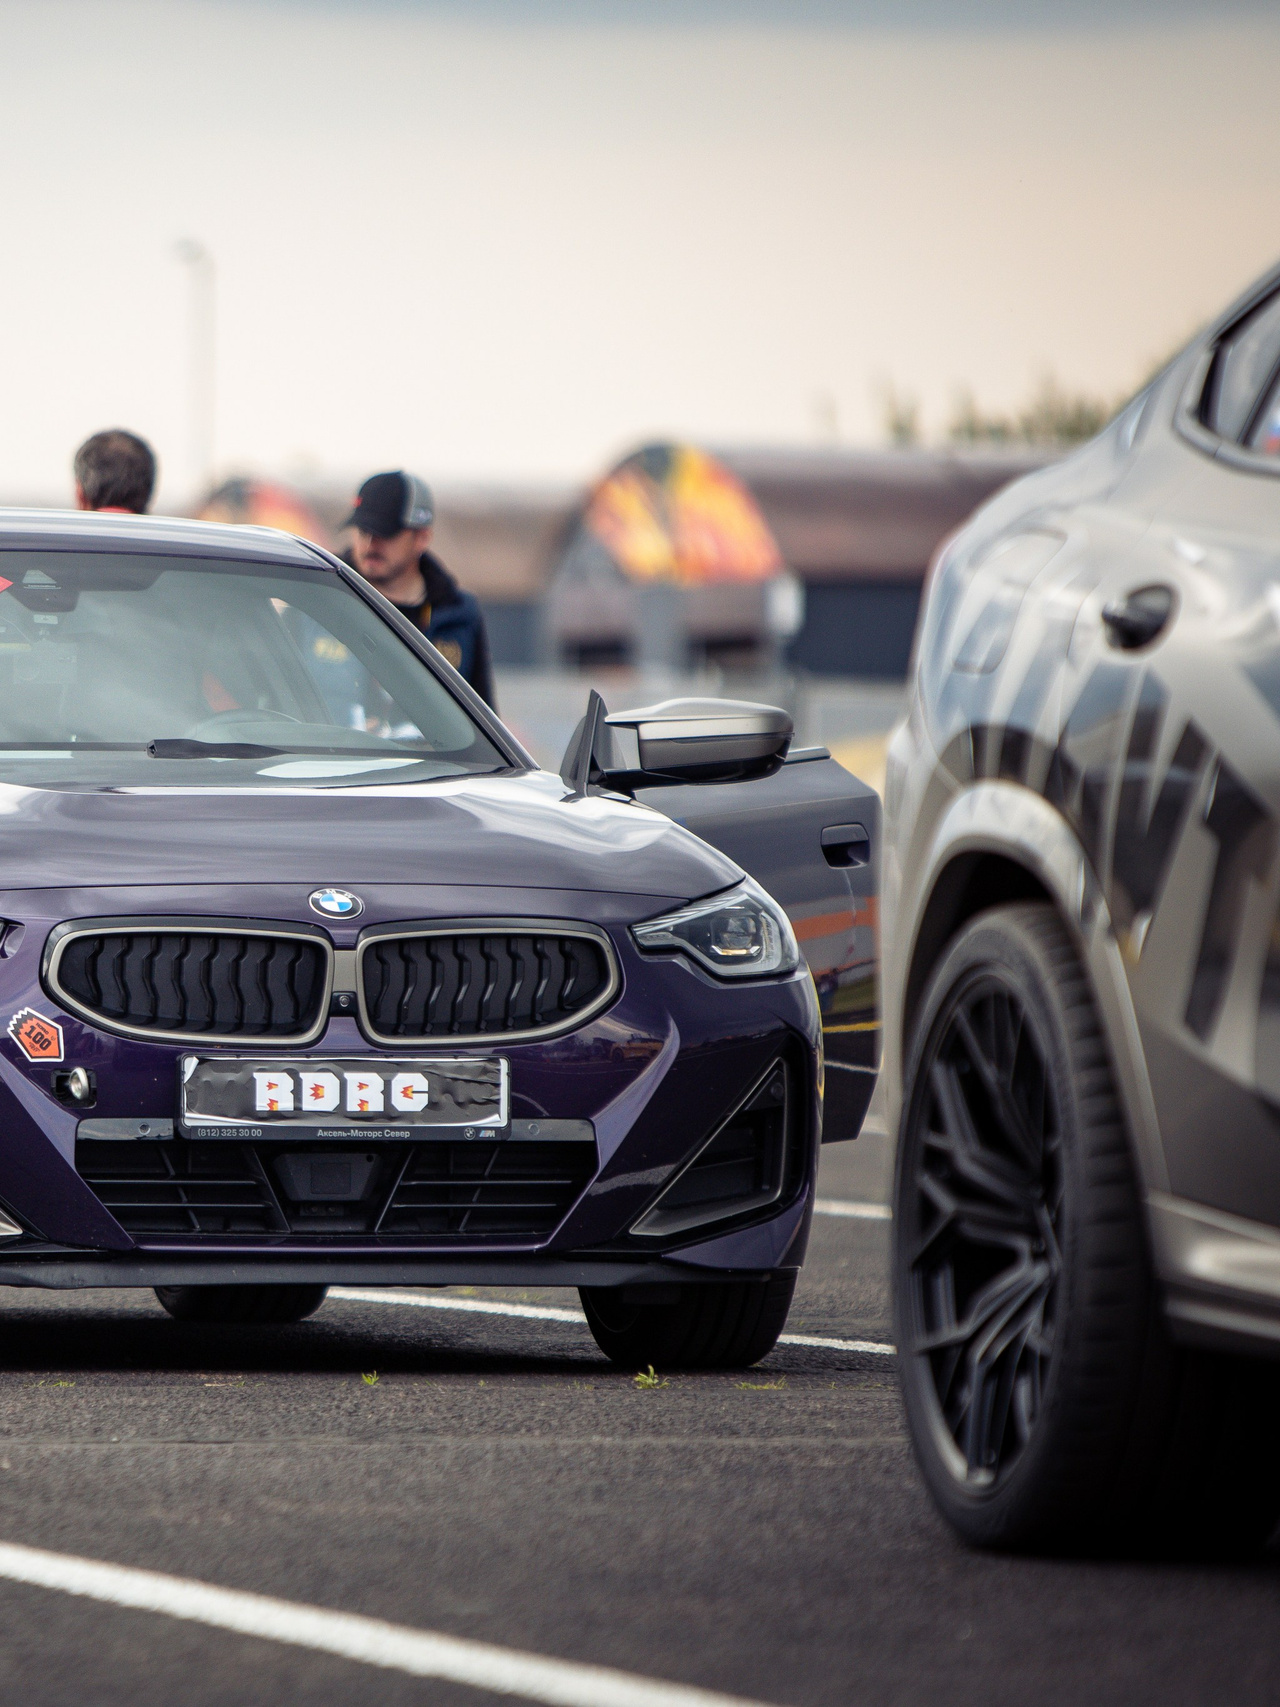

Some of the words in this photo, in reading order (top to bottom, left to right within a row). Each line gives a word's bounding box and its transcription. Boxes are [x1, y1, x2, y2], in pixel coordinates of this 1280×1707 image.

[24, 1025, 53, 1051] 100
[253, 1072, 429, 1112] RDRC
[197, 1128, 220, 1138] (812)
[221, 1128, 238, 1137] 325
[238, 1128, 249, 1137] 30
[250, 1128, 262, 1137] 00
[317, 1129, 383, 1138] Аксель-Моторс
[383, 1129, 411, 1139] Север
